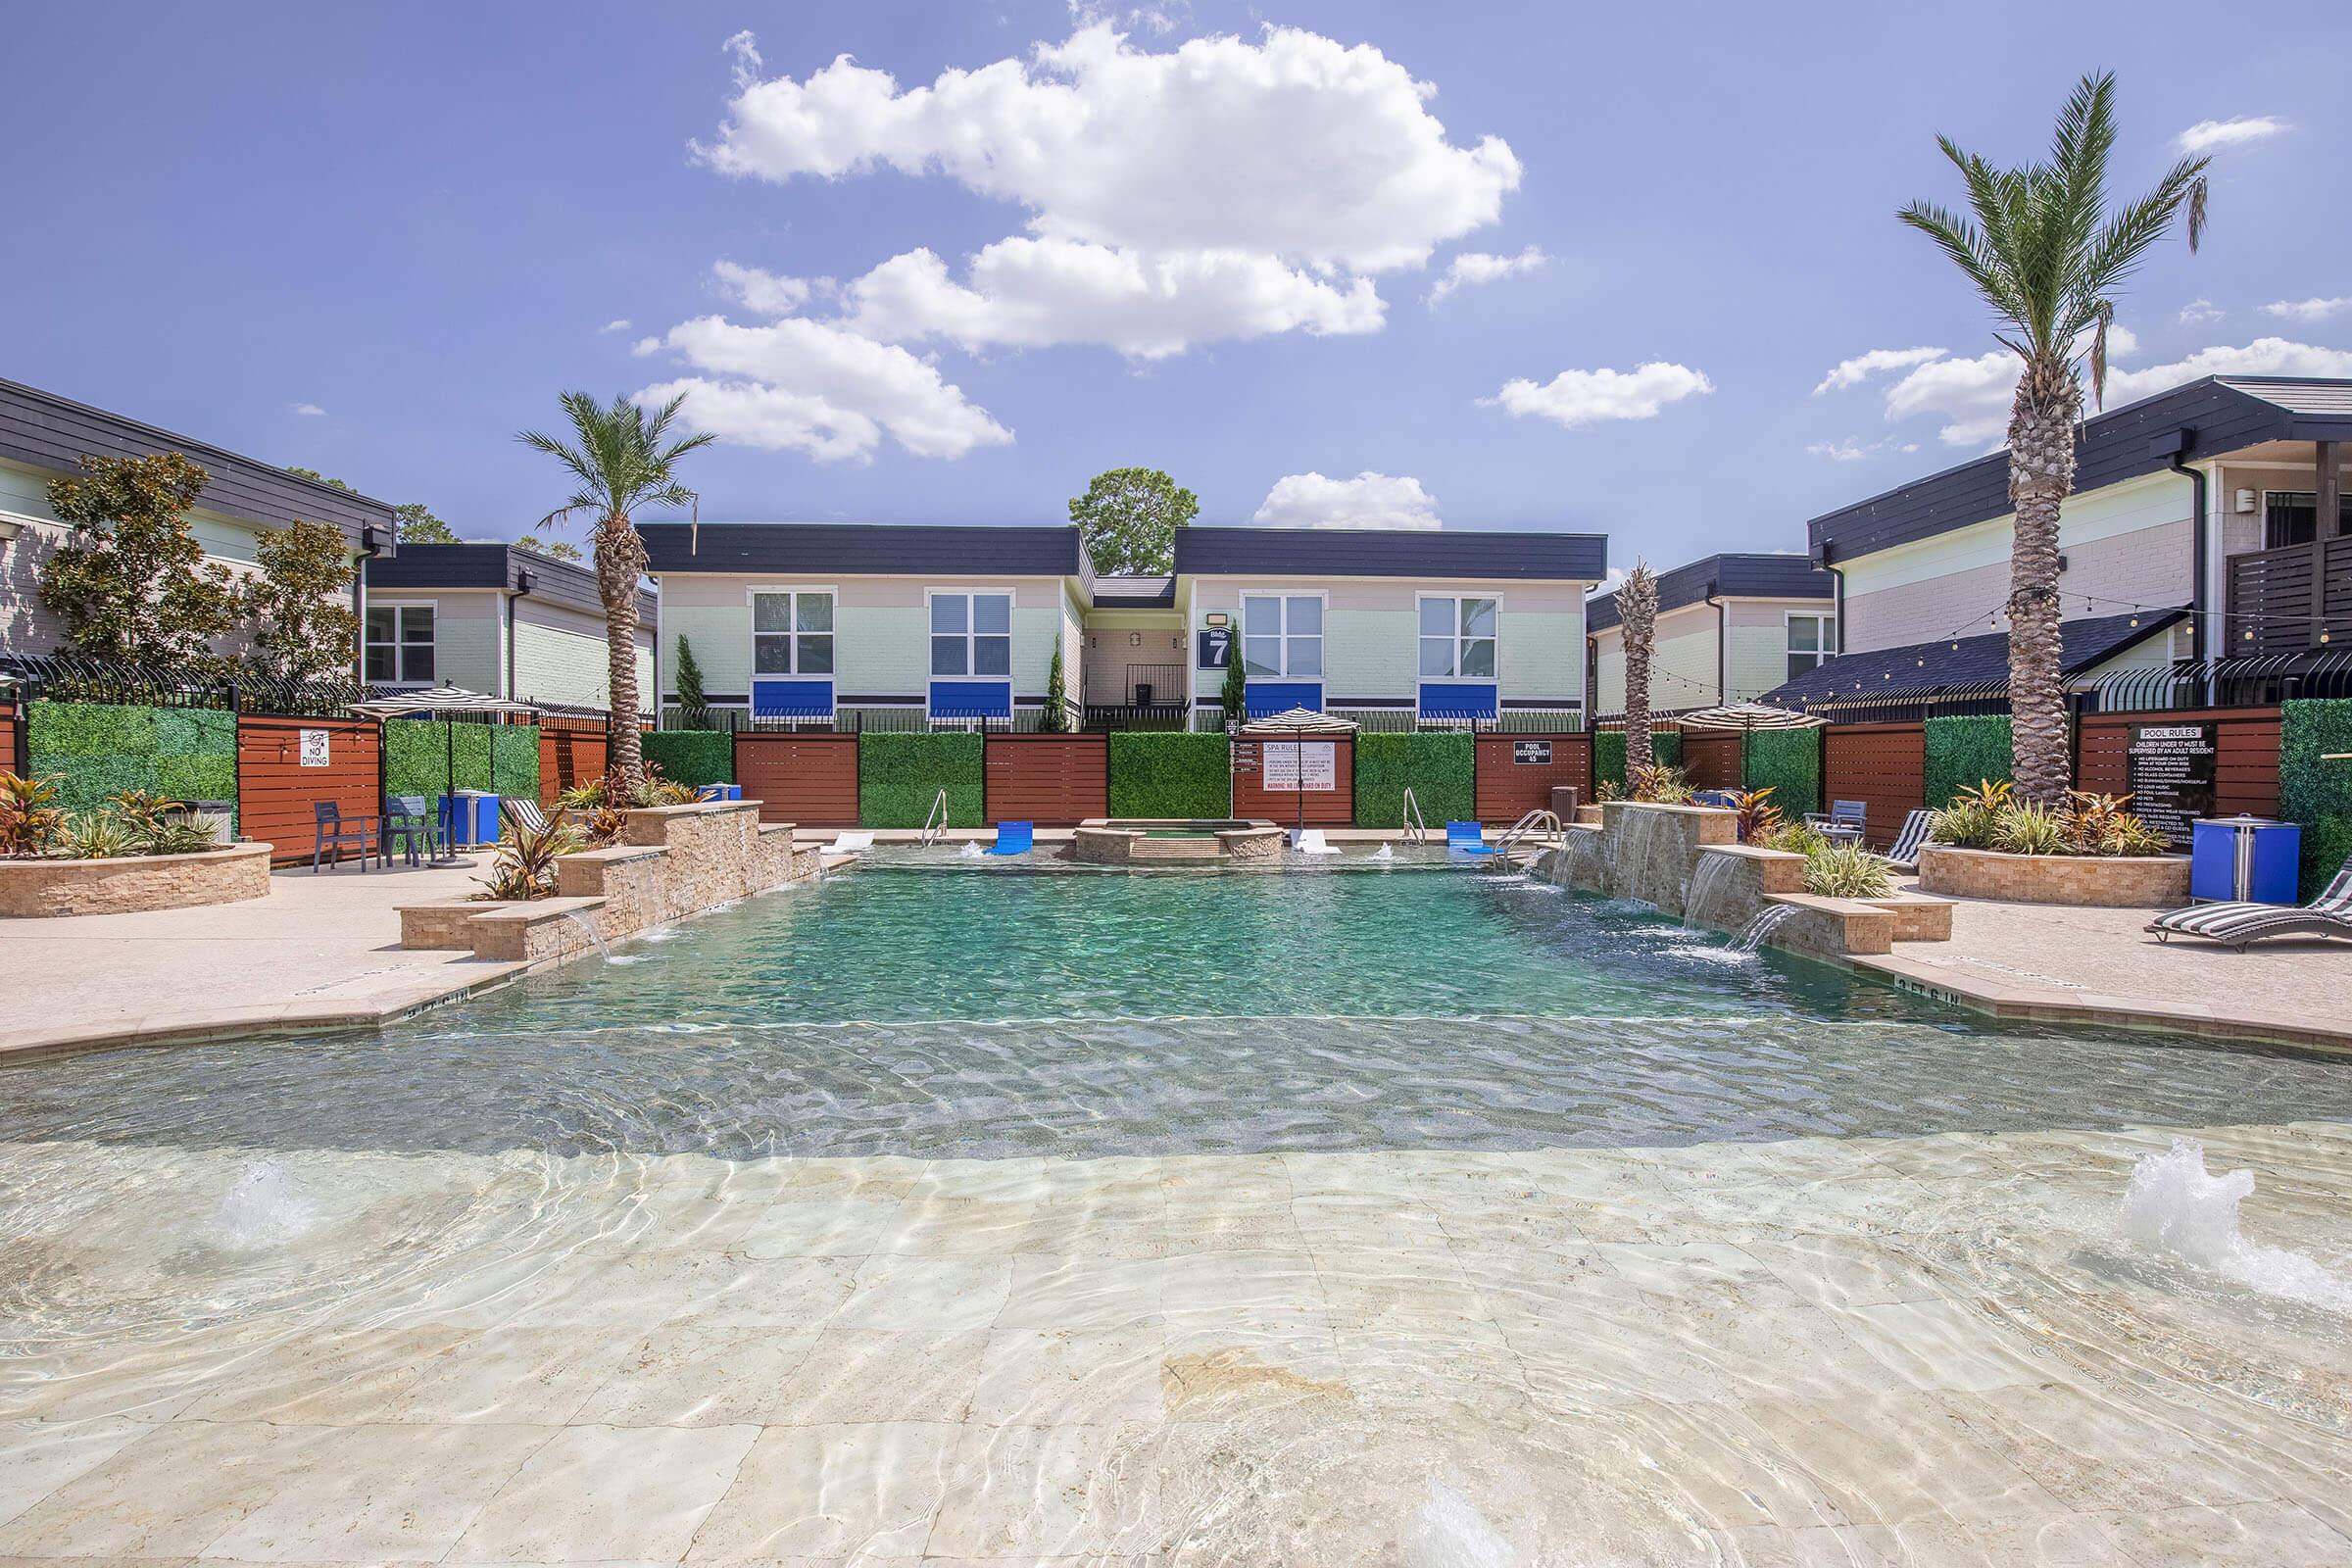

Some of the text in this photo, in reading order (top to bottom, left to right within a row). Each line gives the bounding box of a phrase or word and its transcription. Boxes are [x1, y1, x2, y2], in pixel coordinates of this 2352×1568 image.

[1209, 640, 1228, 664] 7
[302, 757, 327, 765] DIVING
[1945, 992, 1958, 1004] IN
